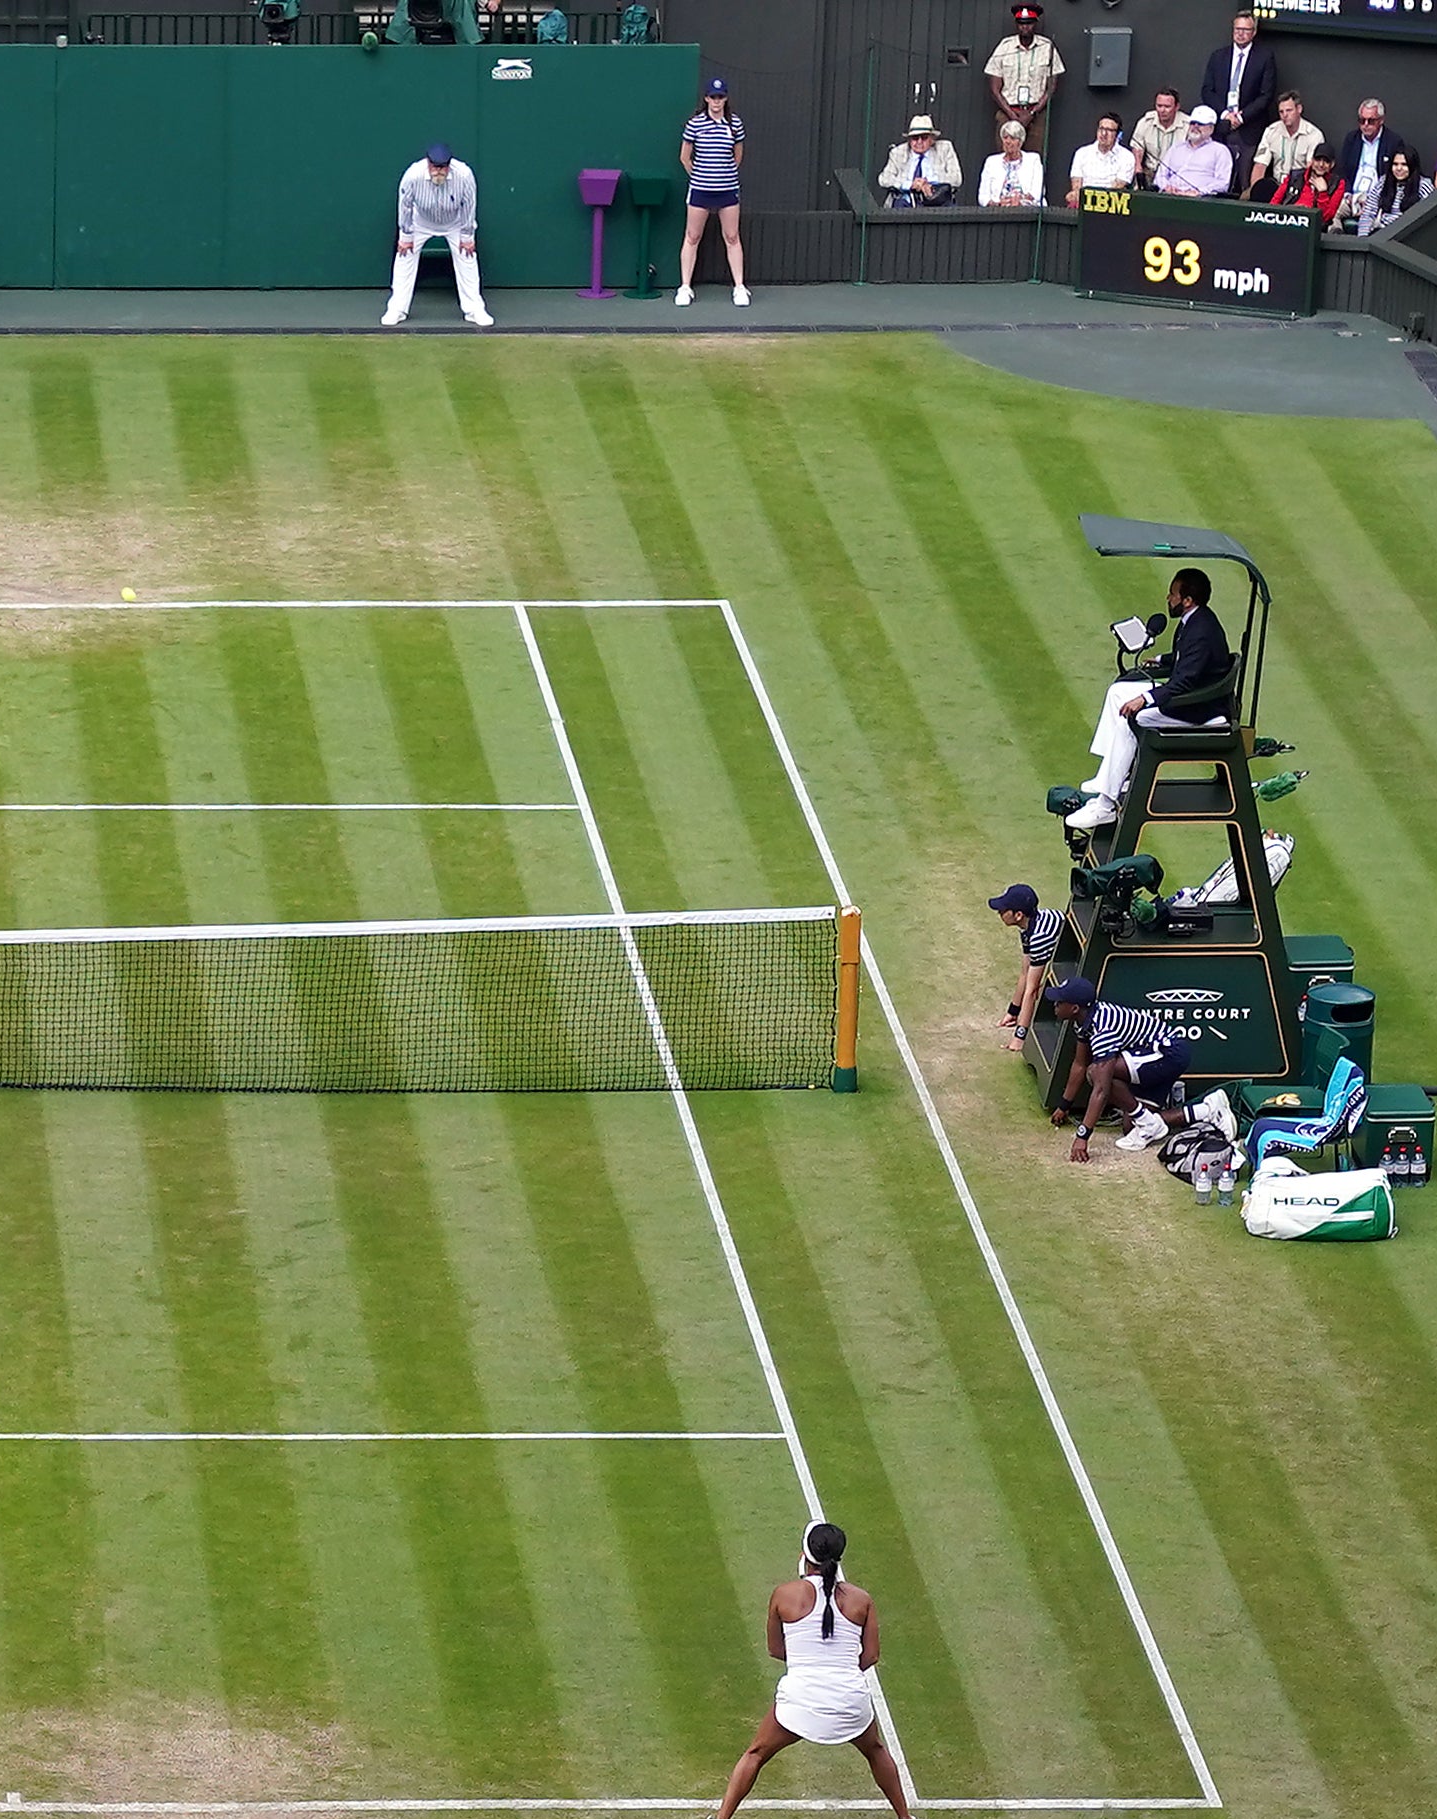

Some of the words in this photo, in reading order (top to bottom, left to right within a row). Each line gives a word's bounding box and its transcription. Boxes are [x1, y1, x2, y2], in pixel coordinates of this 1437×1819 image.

[1083, 189, 1130, 216] IBM
[1244, 210, 1309, 228] JAGUAR
[1143, 236, 1201, 286] 93
[1213, 267, 1269, 296] mph
[1192, 1008, 1251, 1020] COURT
[1274, 1197, 1340, 1206] HEAD
